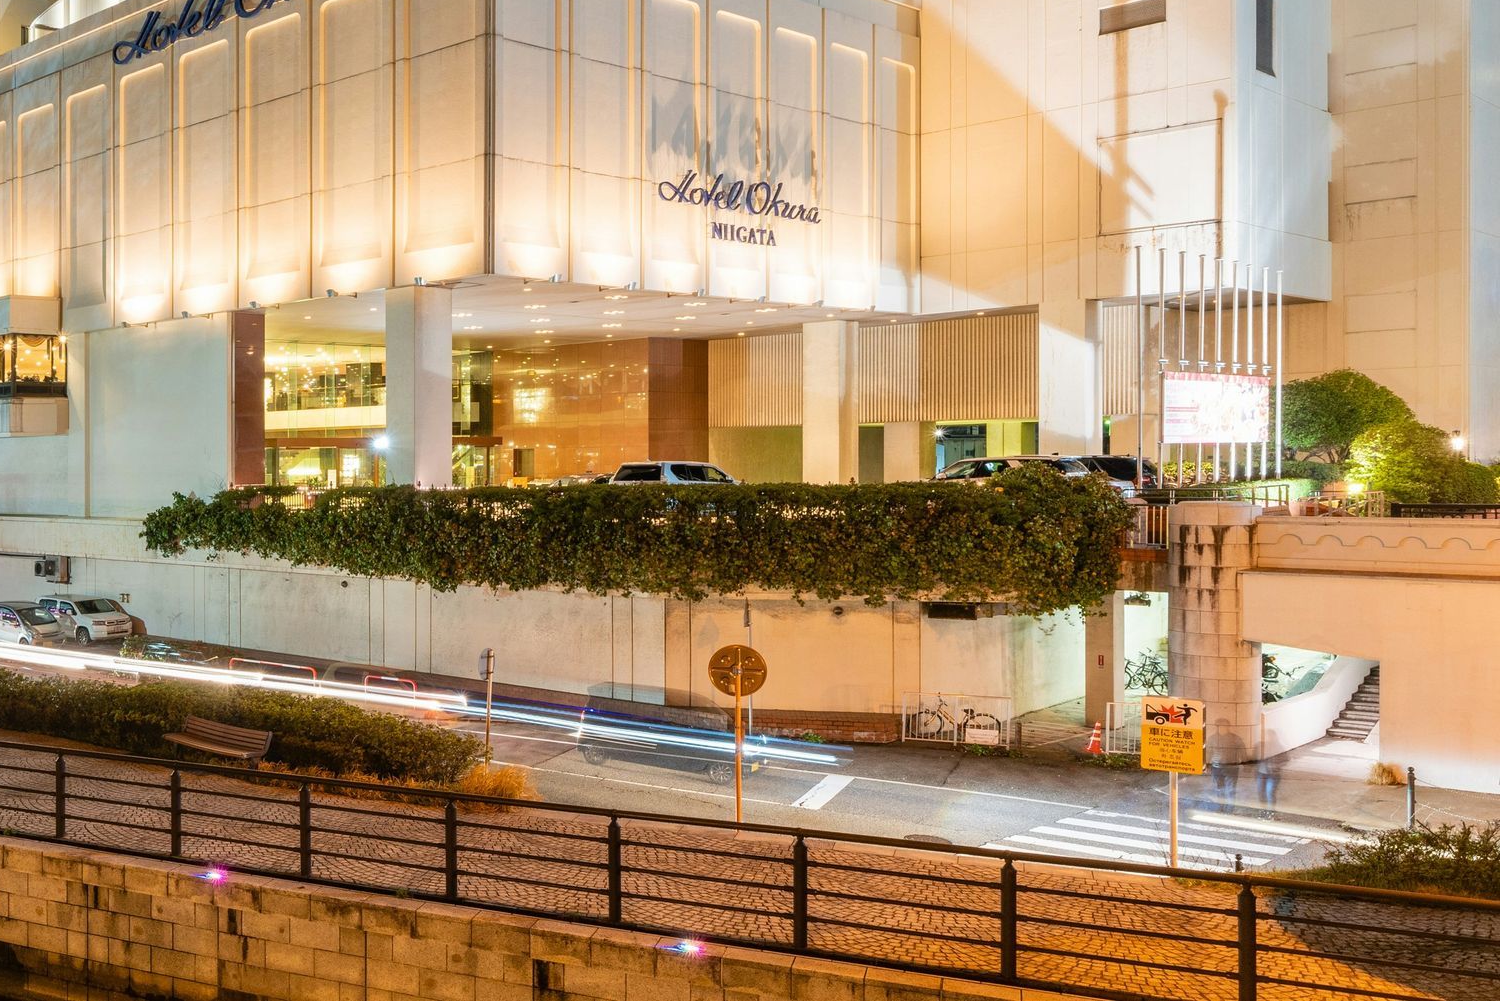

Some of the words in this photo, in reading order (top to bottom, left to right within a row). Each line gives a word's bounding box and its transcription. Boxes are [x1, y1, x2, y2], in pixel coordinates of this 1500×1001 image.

[658, 169, 744, 211] Hotel
[747, 181, 821, 224] Okura
[710, 222, 777, 247] NIIGATA
[1148, 727, 1194, 740] 車に注意
